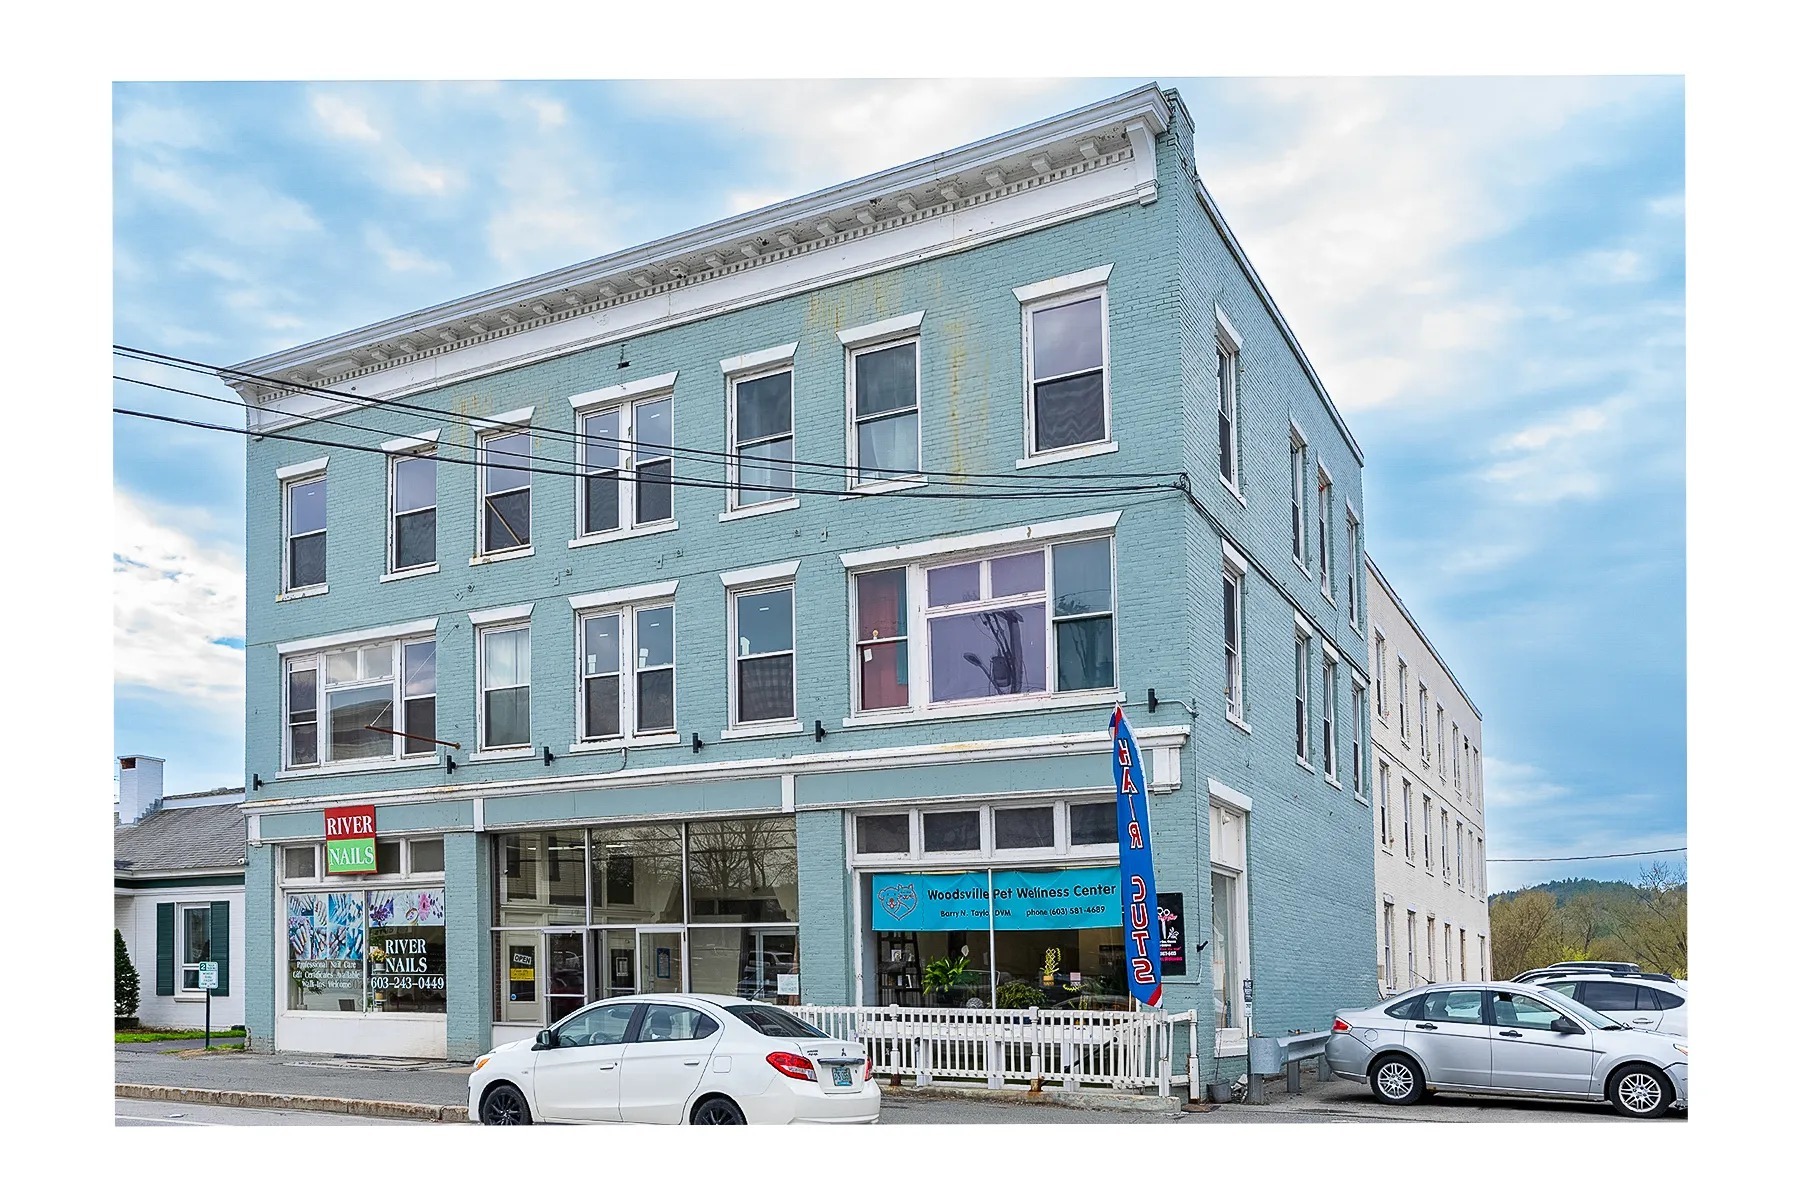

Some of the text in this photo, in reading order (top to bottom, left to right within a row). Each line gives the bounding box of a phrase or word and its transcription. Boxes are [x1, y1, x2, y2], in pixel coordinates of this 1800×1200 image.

[326, 815, 373, 836] RIVER
[329, 846, 375, 866] NAILS
[927, 884, 1117, 900] Woodsville Pet Wellness Center
[940, 910, 960, 918] Barry
[971, 909, 992, 918] Taylo
[994, 909, 1011, 917] DVM
[1026, 908, 1048, 918] phone
[1049, 907, 1068, 917] (603)
[1069, 905, 1106, 916] 581-4689
[385, 938, 427, 954] RIVER
[343, 960, 357, 969] Care
[385, 956, 428, 973] NAILS
[514, 954, 531, 964] OPEN
[370, 976, 445, 990] 603-243-0449
